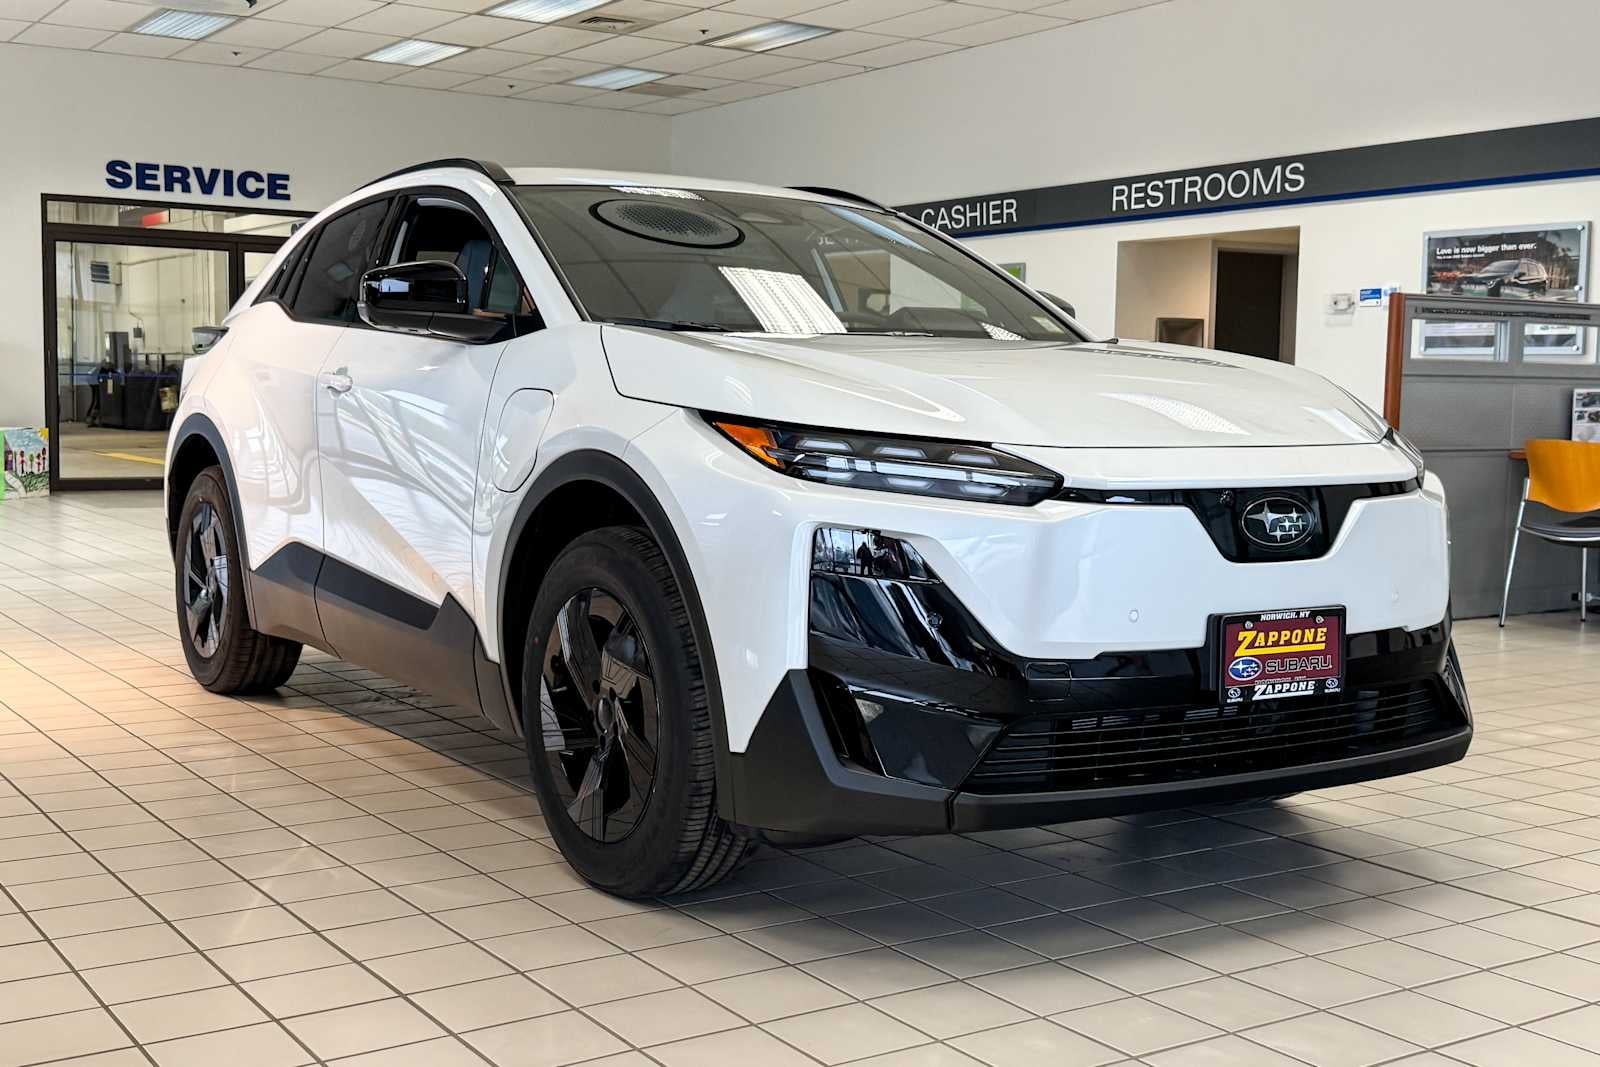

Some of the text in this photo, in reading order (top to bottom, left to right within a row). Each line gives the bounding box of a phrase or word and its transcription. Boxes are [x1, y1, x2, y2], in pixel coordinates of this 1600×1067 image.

[105, 160, 291, 200] SERVICE
[1111, 162, 1305, 212] RESTROOMS
[920, 198, 1017, 231] CASHIER
[1436, 247, 1452, 255] Love
[1453, 246, 1460, 254] is
[1477, 244, 1500, 253] bigger
[1501, 243, 1517, 251] than
[1234, 627, 1328, 657] ZAPPONE
[1265, 655, 1332, 674] SUBARU
[1252, 681, 1316, 701] ZAPPONE
